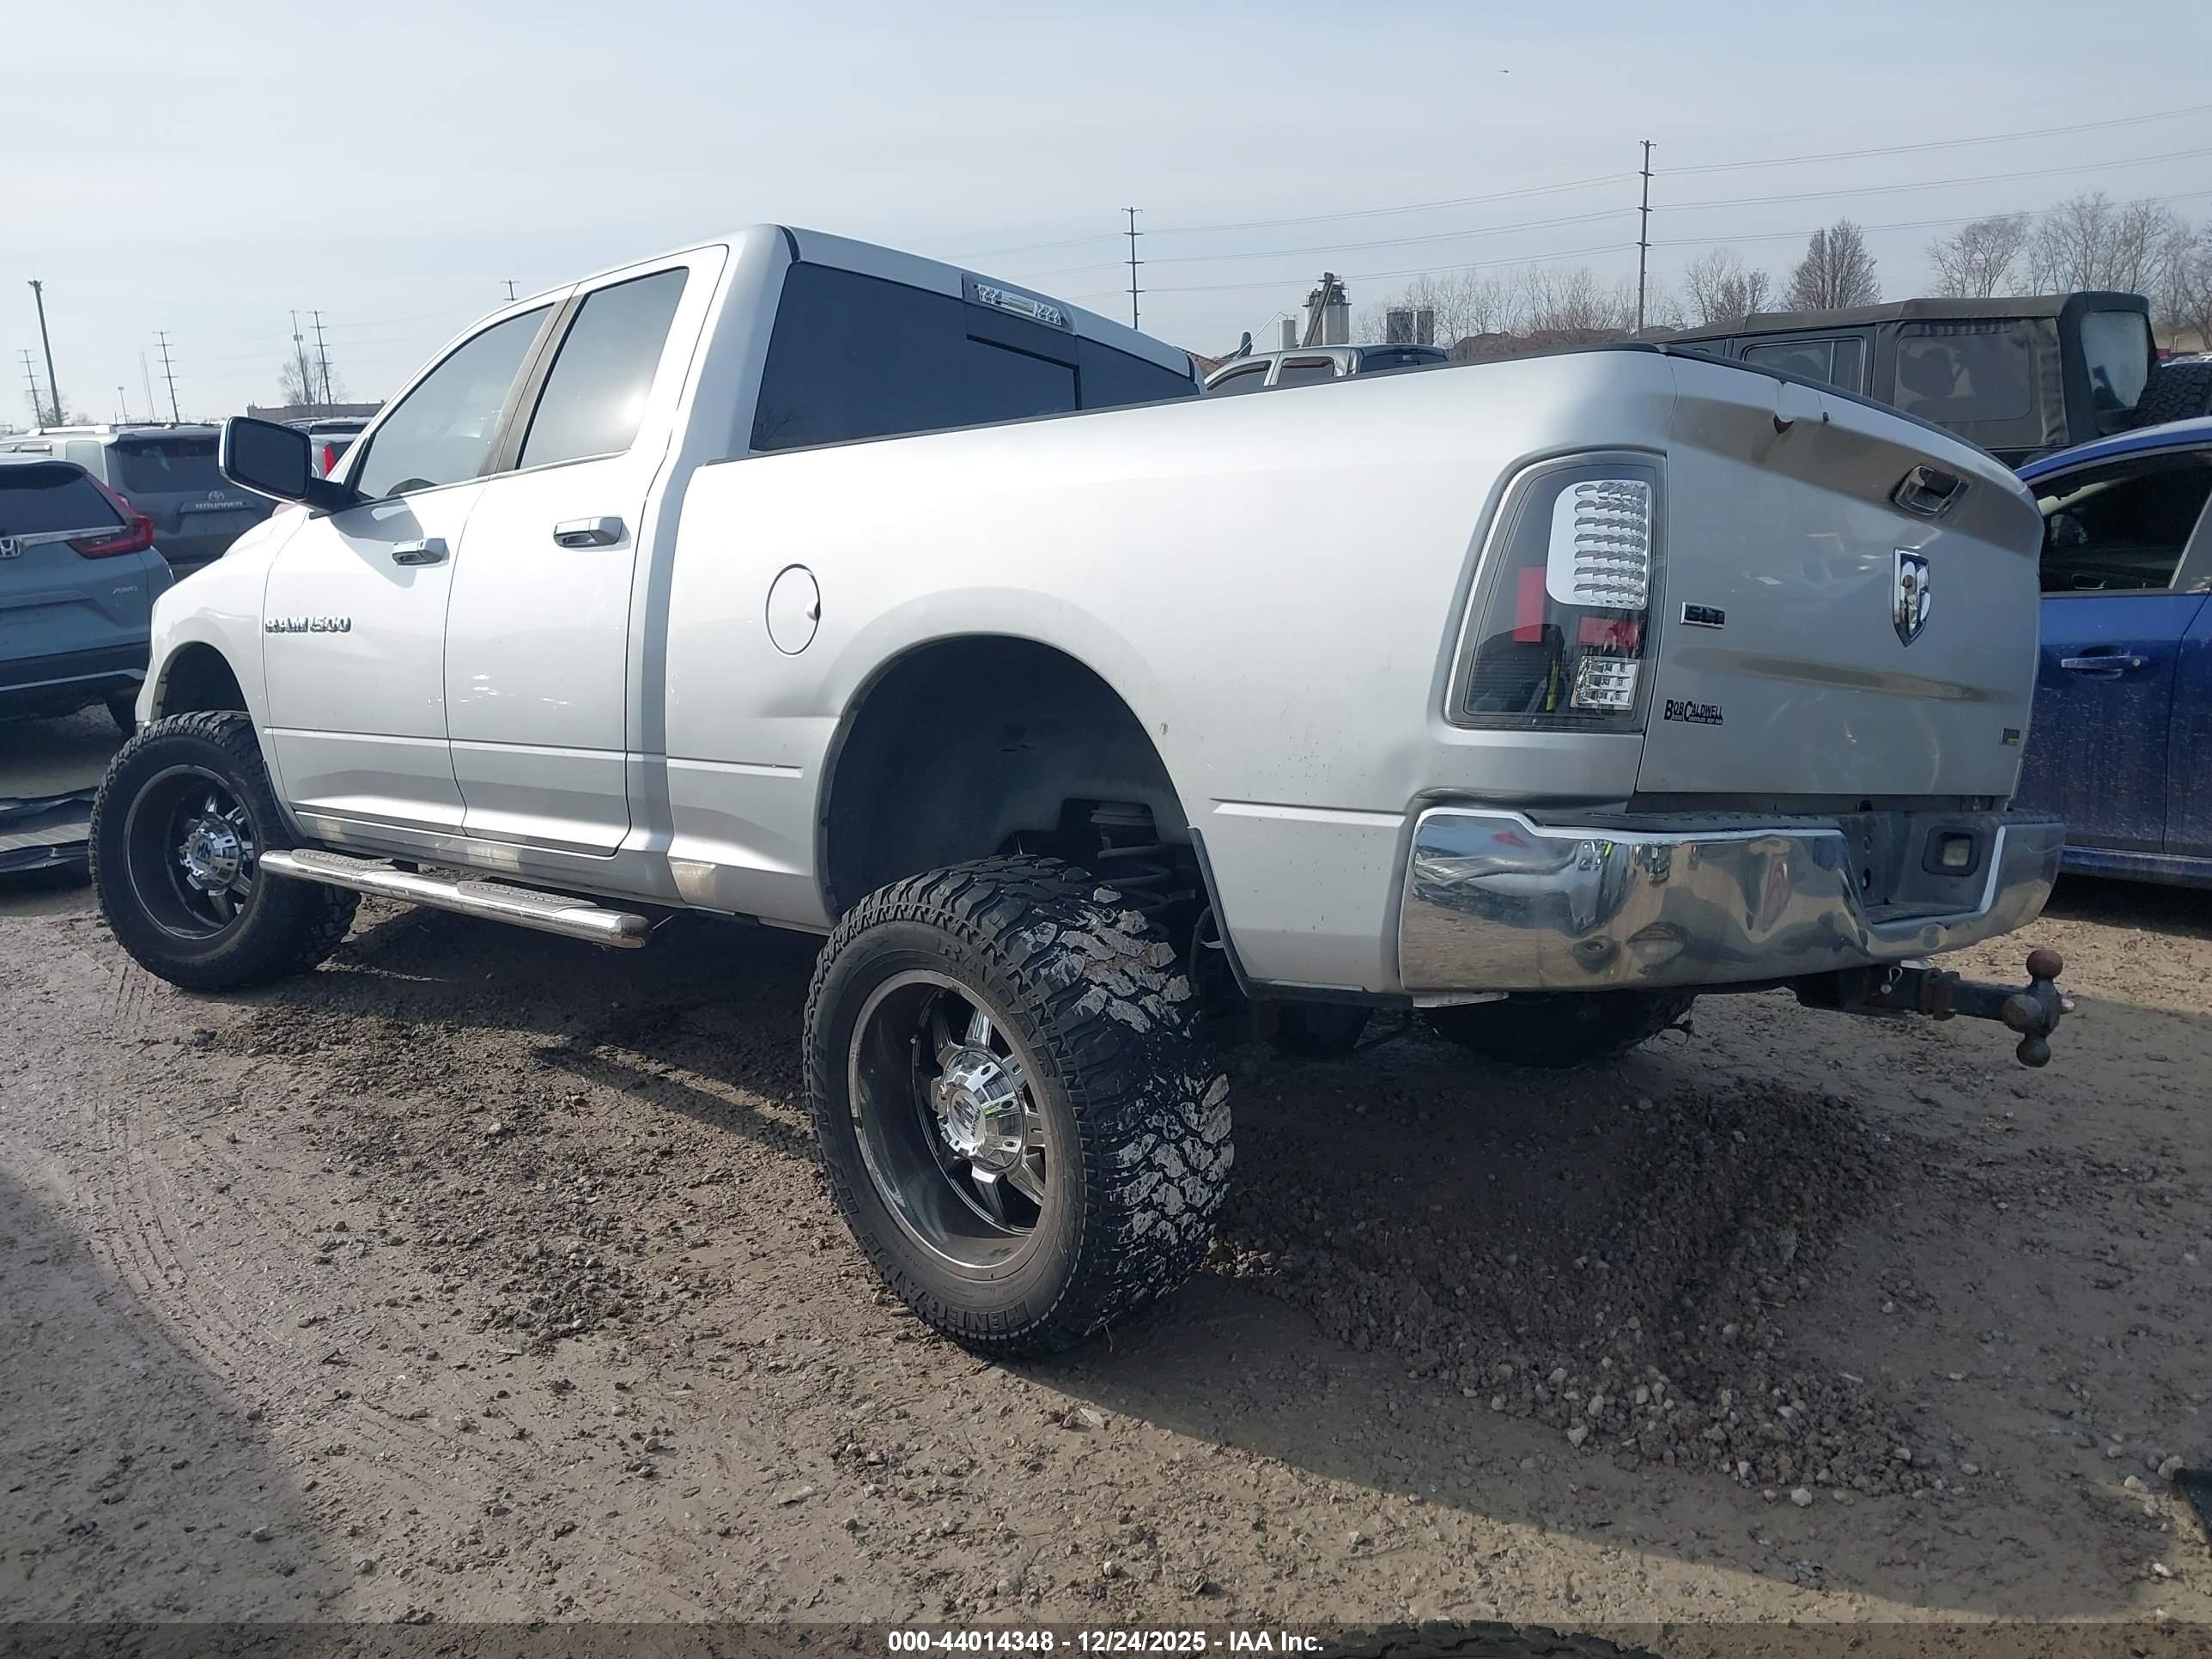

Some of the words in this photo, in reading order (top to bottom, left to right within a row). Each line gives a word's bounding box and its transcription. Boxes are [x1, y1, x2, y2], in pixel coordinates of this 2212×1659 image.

[264, 617, 308, 633] RAM
[309, 616, 351, 633] 1500
[1663, 699, 1685, 721] BOB
[1684, 700, 1723, 725] CALDWELL
[936, 934, 1058, 1079] RADAR
[859, 1231, 1030, 1332] RENEGADE
